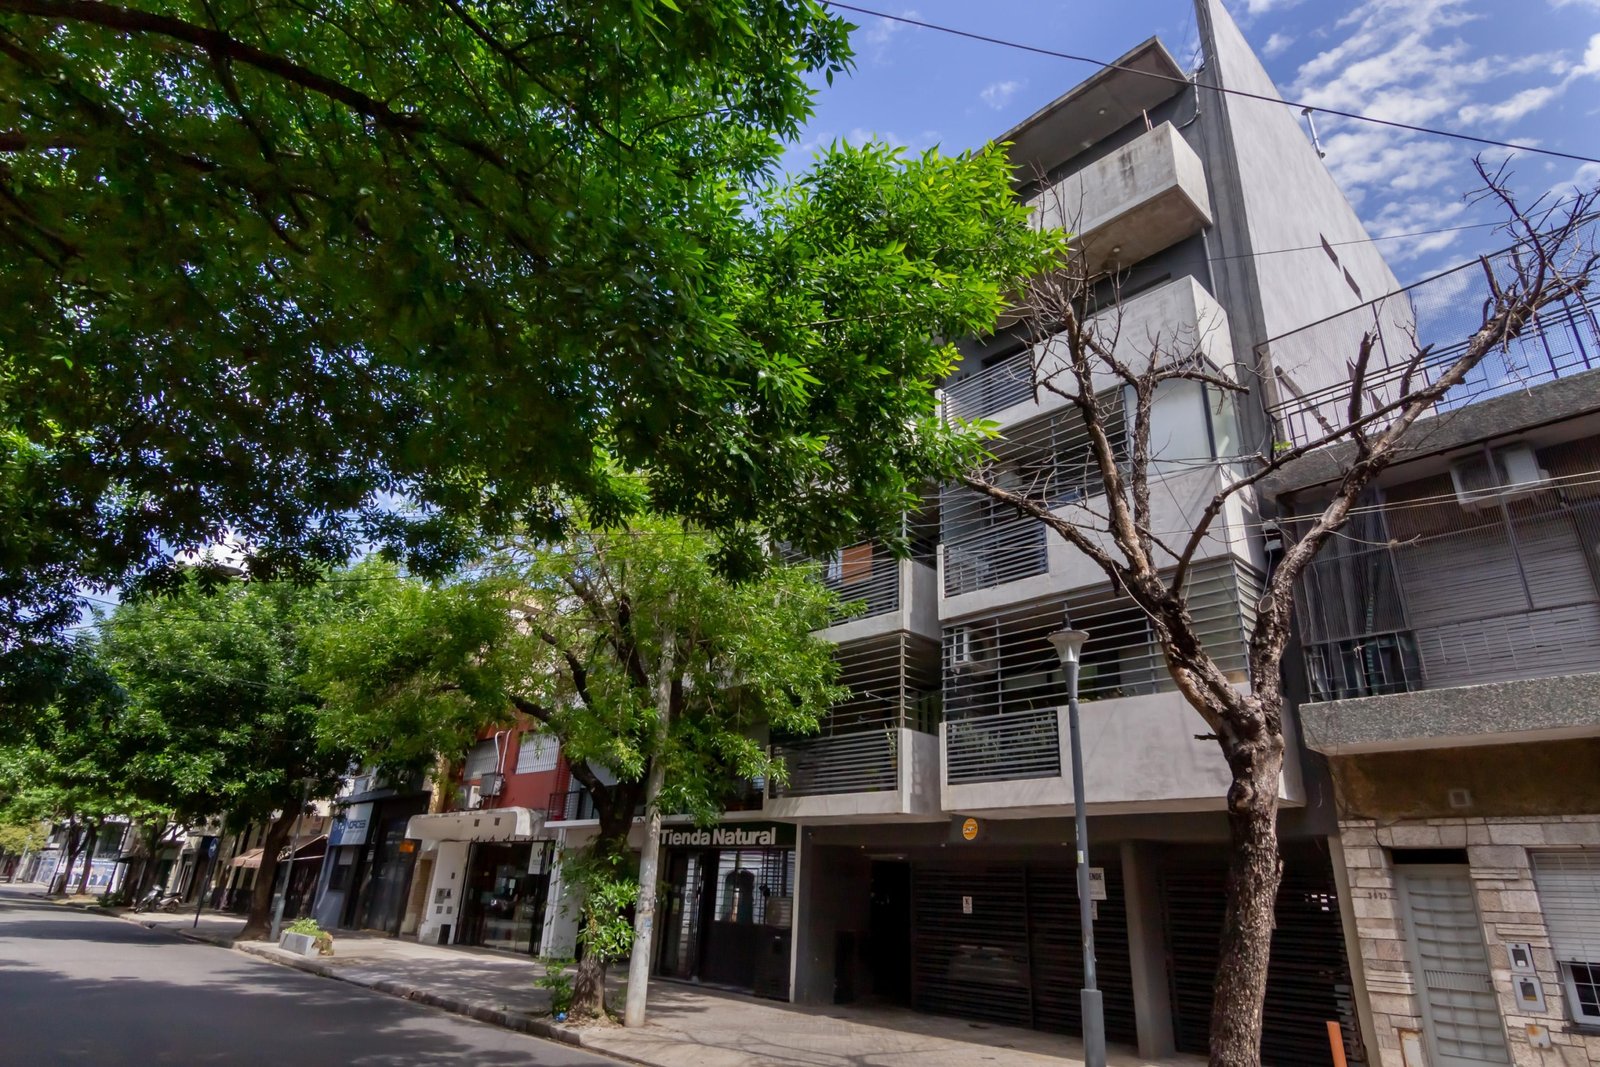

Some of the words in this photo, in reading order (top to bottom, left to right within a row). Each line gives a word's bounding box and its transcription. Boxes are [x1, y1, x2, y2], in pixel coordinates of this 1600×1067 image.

[660, 829, 710, 845] Tienda
[712, 827, 776, 845] Natural
[1088, 873, 1102, 881] ENDE
